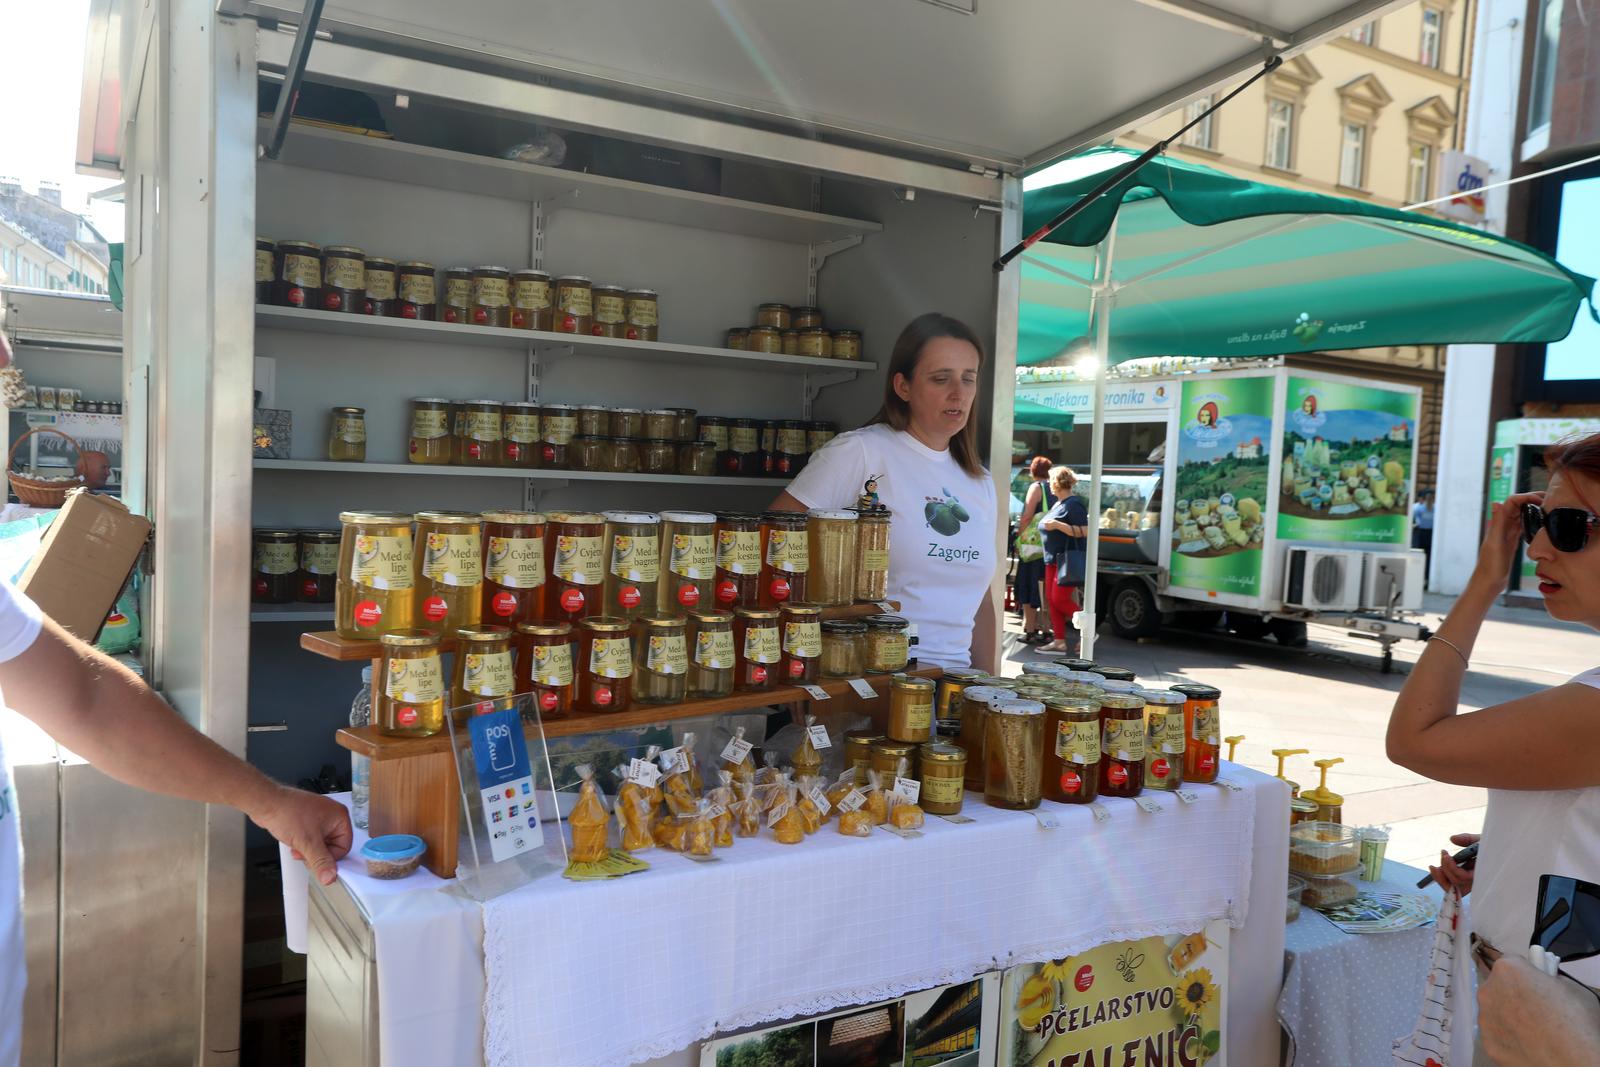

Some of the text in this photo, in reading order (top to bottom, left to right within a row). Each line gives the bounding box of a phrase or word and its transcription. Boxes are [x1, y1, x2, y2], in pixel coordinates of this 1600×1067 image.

[1458, 164, 1484, 197] dm
[1104, 389, 1145, 405] eronika
[694, 546, 710, 555] Med
[737, 543, 753, 552] Med
[788, 543, 803, 551] Med
[381, 551, 400, 562] Med
[451, 549, 471, 559] Med
[636, 548, 652, 557] Med
[928, 543, 979, 563] Zagorje
[391, 563, 407, 575] lipe
[460, 560, 476, 571] lipe
[518, 562, 537, 572] med
[801, 632, 814, 640] Med
[410, 669, 437, 678] Med od
[486, 665, 501, 674] Med
[418, 678, 432, 688] lipe
[494, 673, 507, 683] lipe
[486, 725, 508, 738] POS
[1077, 733, 1094, 743] Med
[1085, 742, 1097, 753] lipe
[487, 794, 502, 804] VISA
[1041, 986, 1174, 1039] PČELARSTVO
